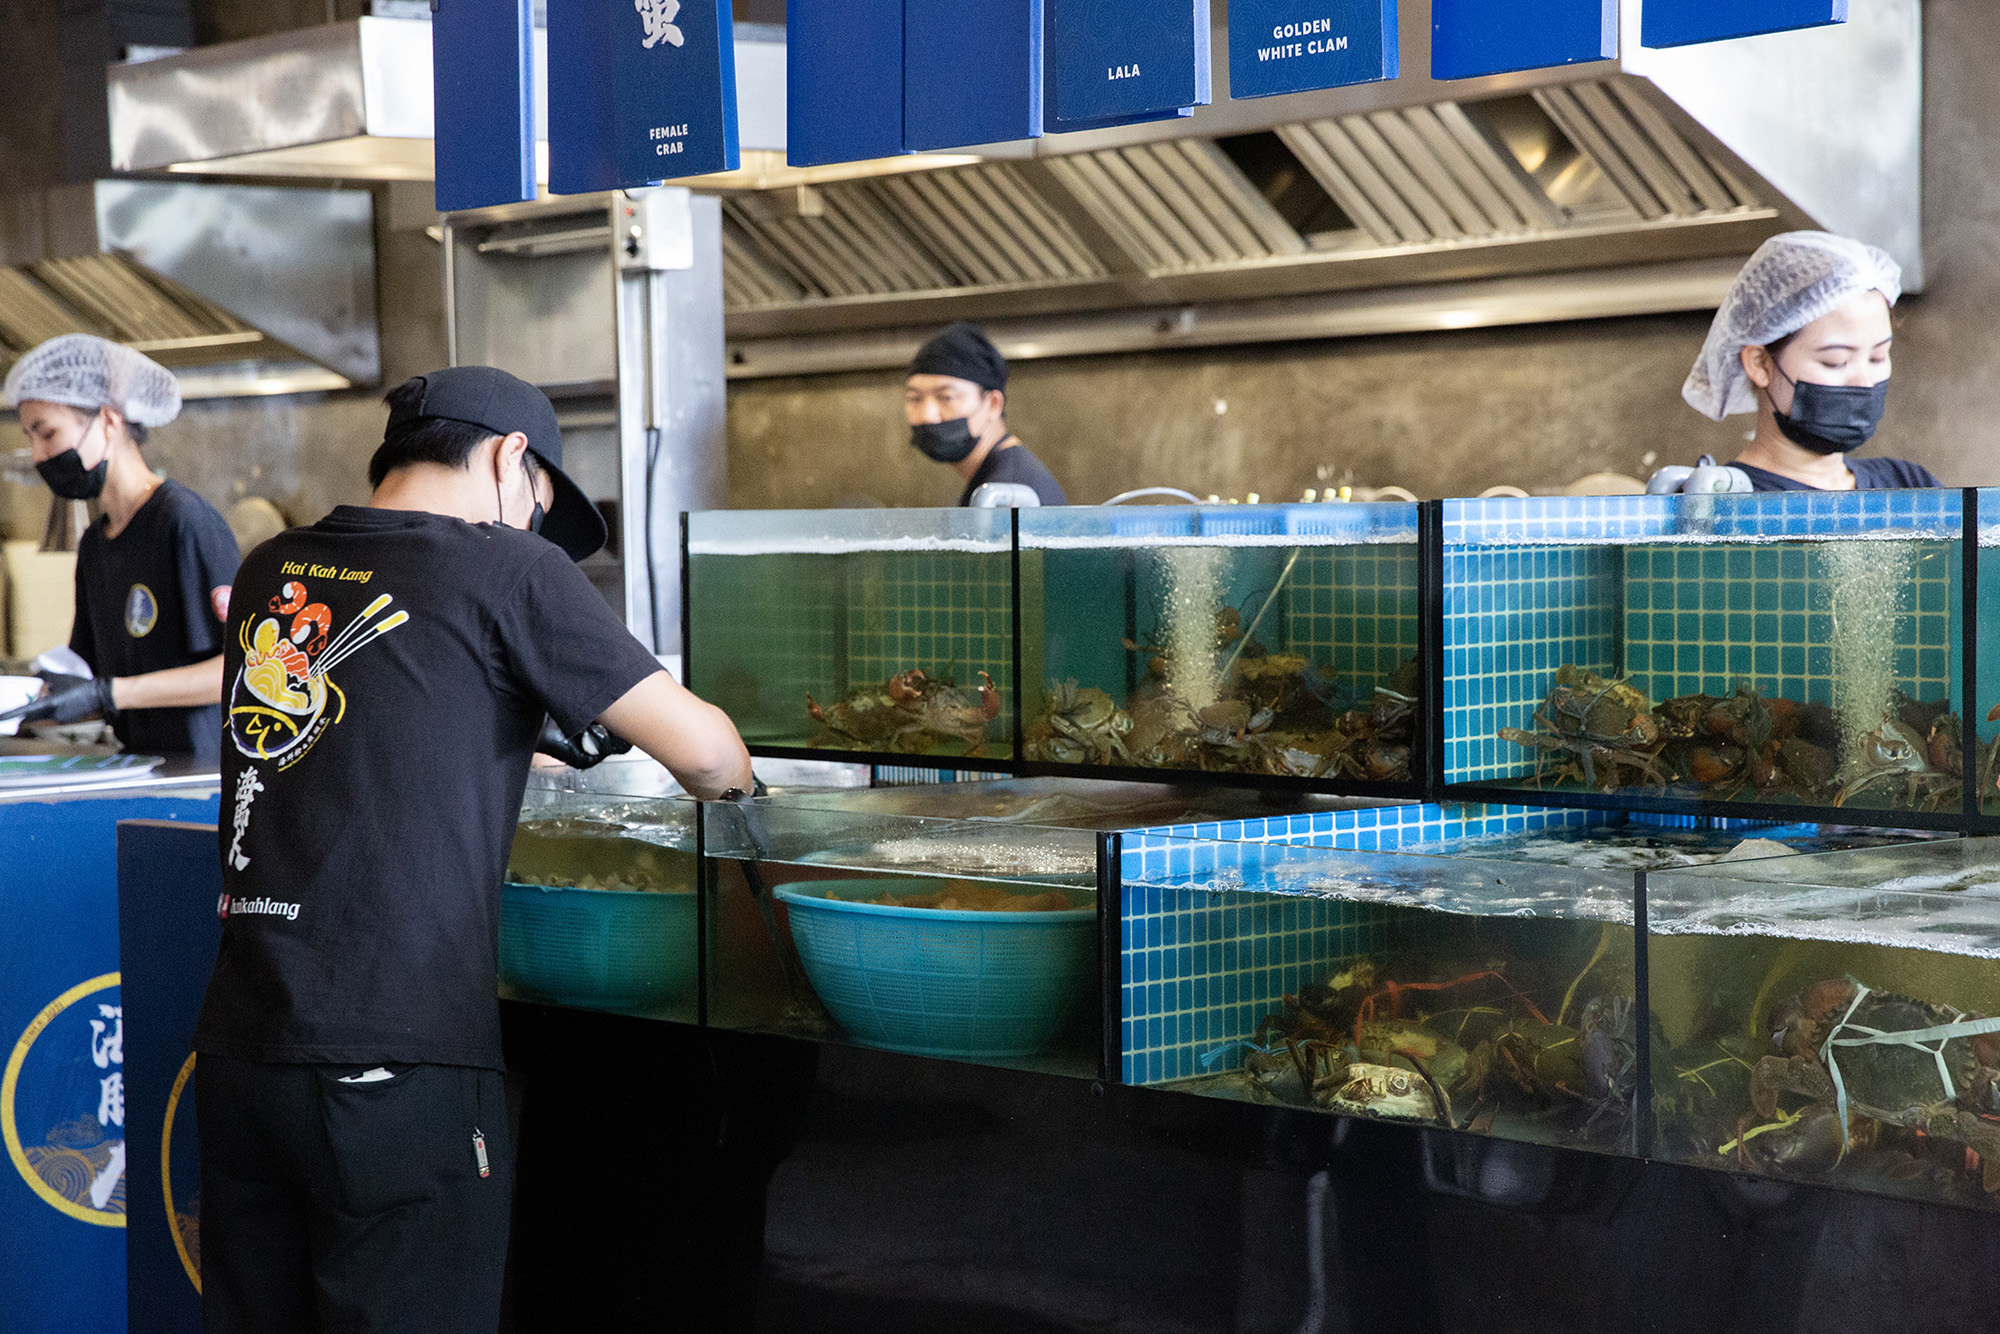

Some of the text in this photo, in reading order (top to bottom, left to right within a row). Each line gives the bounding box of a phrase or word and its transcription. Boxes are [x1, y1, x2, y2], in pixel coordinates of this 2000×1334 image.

[1273, 17, 1331, 40] GOLDEN
[1257, 36, 1348, 62] WHITE CLAM
[1108, 63, 1141, 81] LALA
[649, 123, 689, 141] FEMALE
[656, 141, 684, 156] CRAB
[281, 561, 374, 584] Hai Kah Lang
